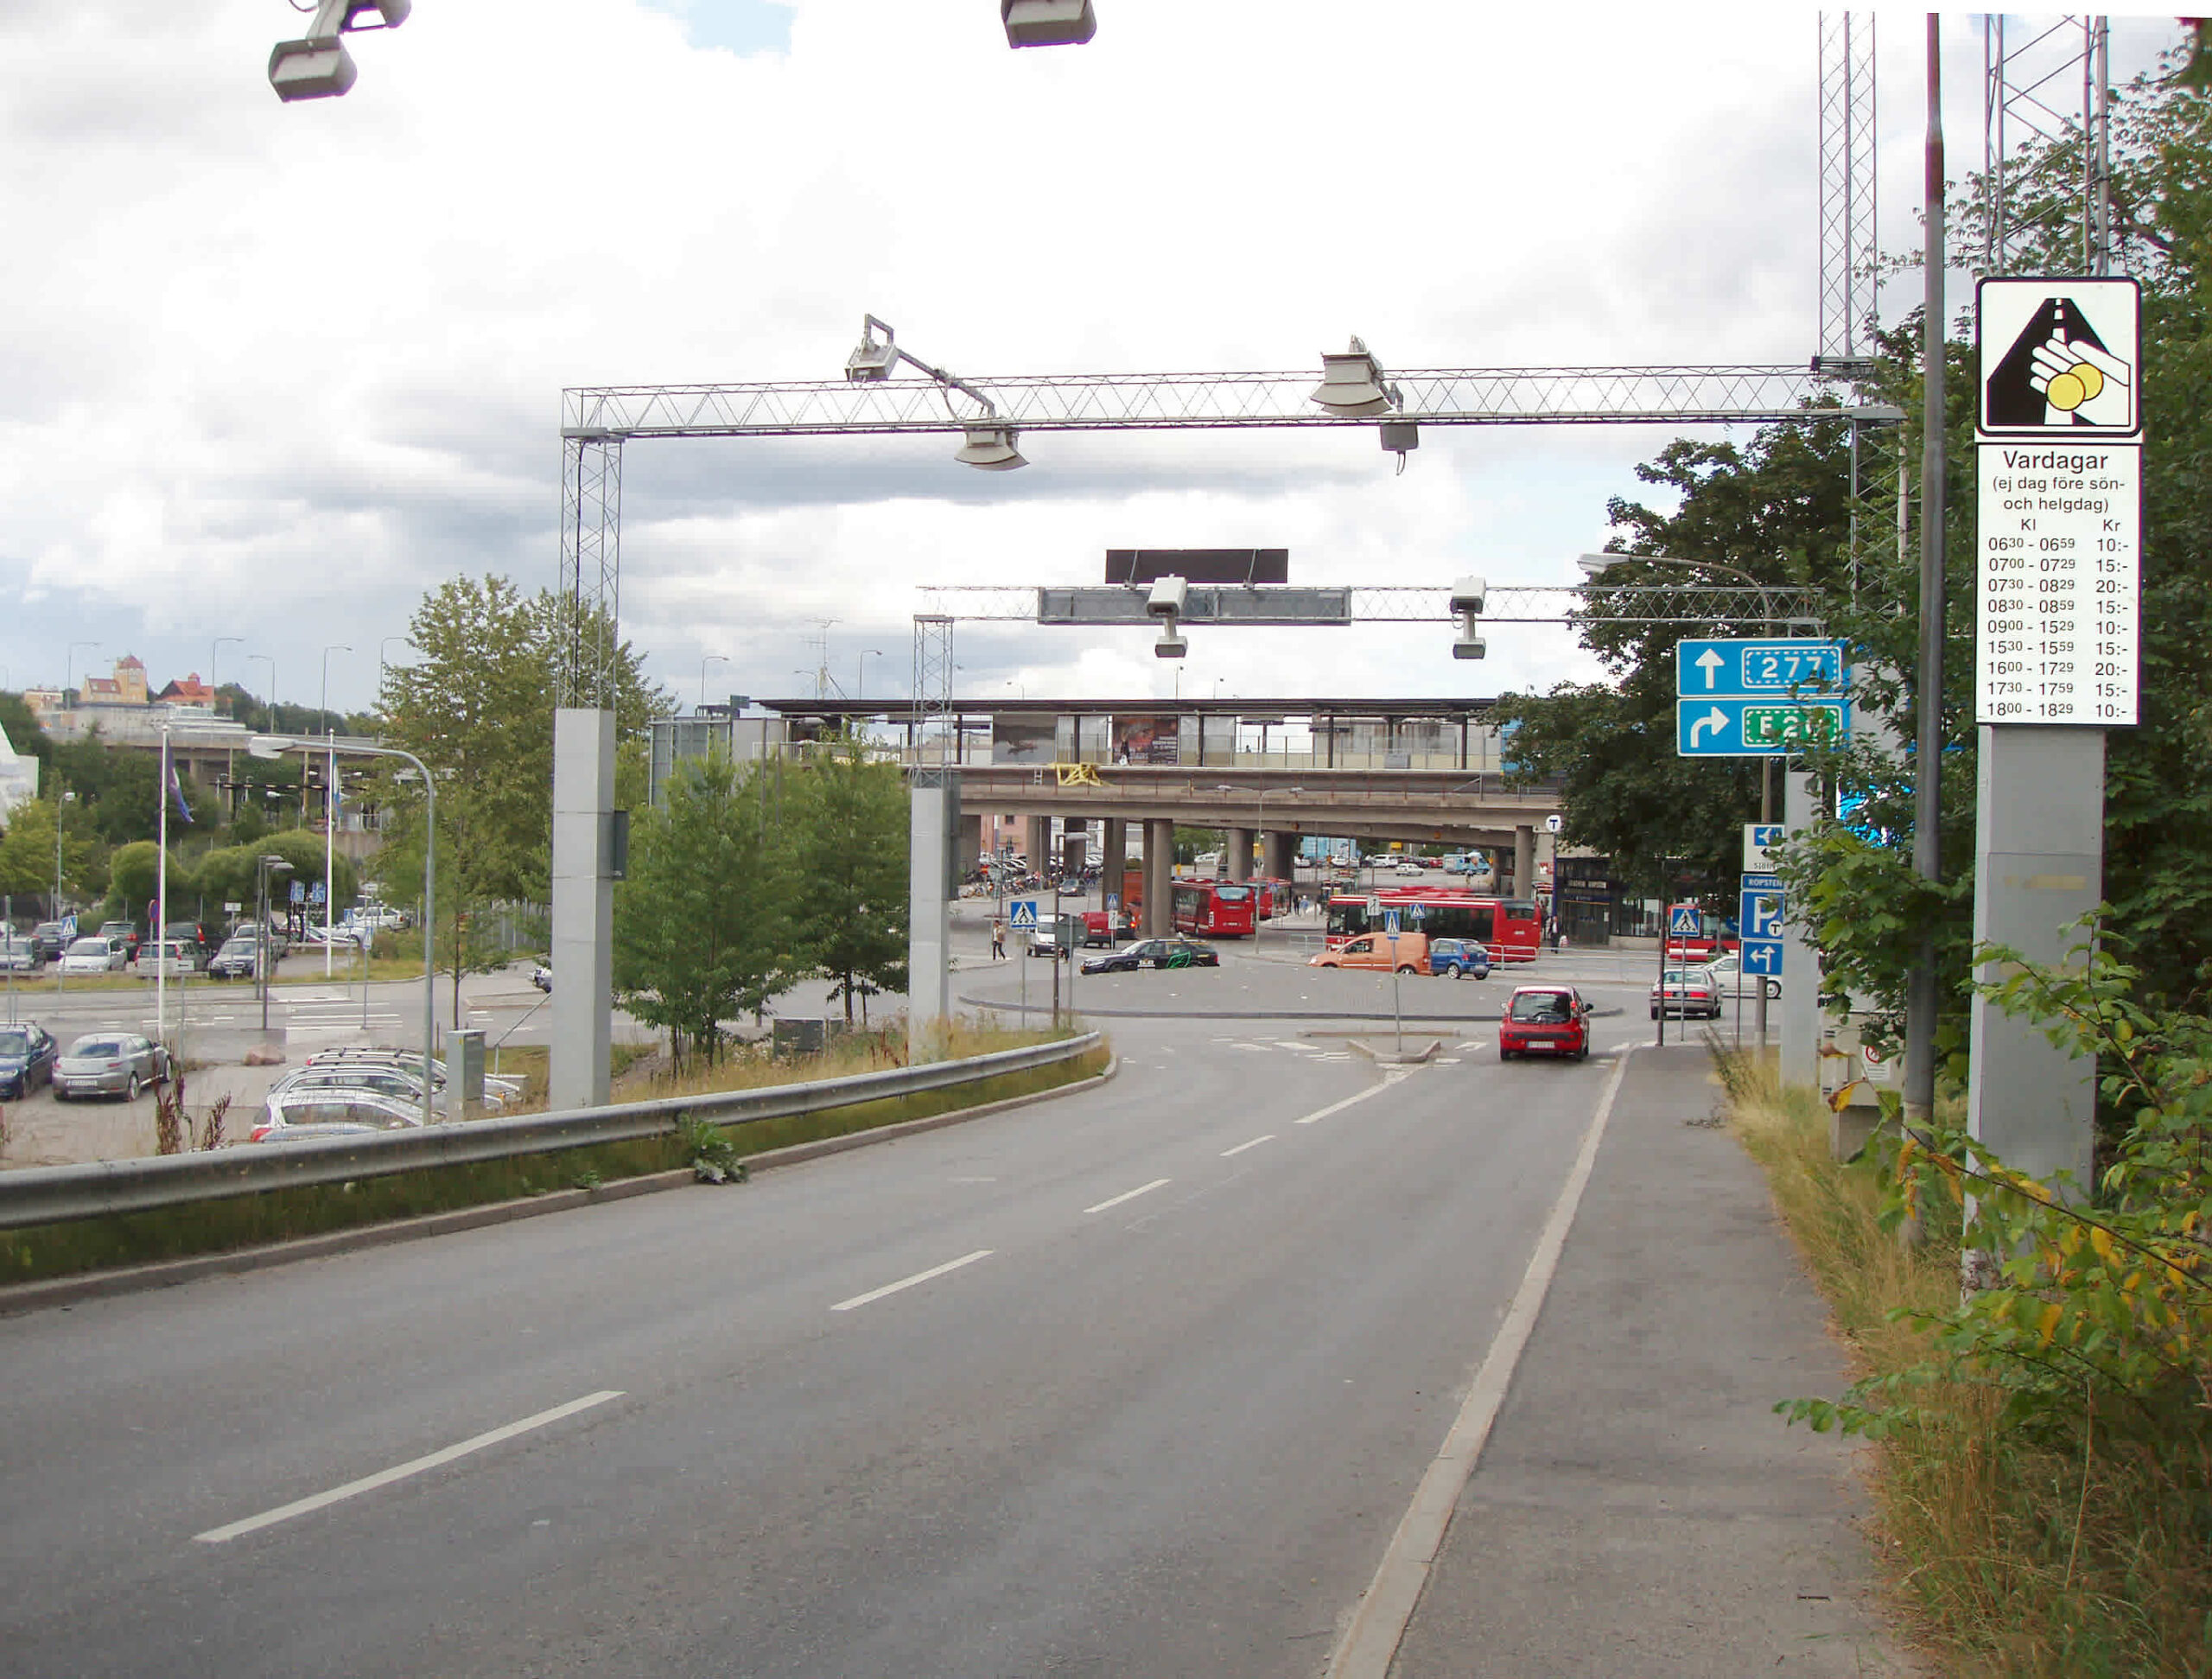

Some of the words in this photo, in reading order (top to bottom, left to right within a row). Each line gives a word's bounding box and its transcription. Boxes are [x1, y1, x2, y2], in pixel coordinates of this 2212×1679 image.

[2003, 449, 2109, 474] Vardagar
[1993, 476, 2012, 493] (ej
[2018, 476, 2047, 493] dag
[2053, 476, 2084, 490] före
[2089, 476, 2125, 489] sön-
[2003, 498, 2033, 511] och
[2038, 497, 2109, 514] helgdag)
[2021, 518, 2036, 531] Kl
[2103, 518, 2121, 531] Kr
[1988, 537, 2024, 550] 0630
[2040, 537, 2075, 551] 0659
[1988, 557, 2024, 571] 0700
[2040, 557, 2075, 572] 0729
[1988, 578, 2024, 592] 0730
[2039, 578, 2075, 593] 0829
[1988, 599, 2024, 613] 0830
[2039, 599, 2075, 614] 0859
[1987, 620, 2024, 633] 0900
[2039, 620, 2075, 634] 1529
[1988, 640, 2023, 654] 1530
[2039, 640, 2075, 655] 1559
[1761, 656, 1822, 678] 277
[1987, 661, 2023, 675] 1600
[2039, 661, 2074, 676] 1729
[1987, 681, 2023, 696] 1730
[2038, 681, 2074, 697] 1759
[1987, 702, 2022, 717] 1800
[2038, 702, 2074, 718] 1829
[1748, 877, 1783, 887] ROPSTEN
